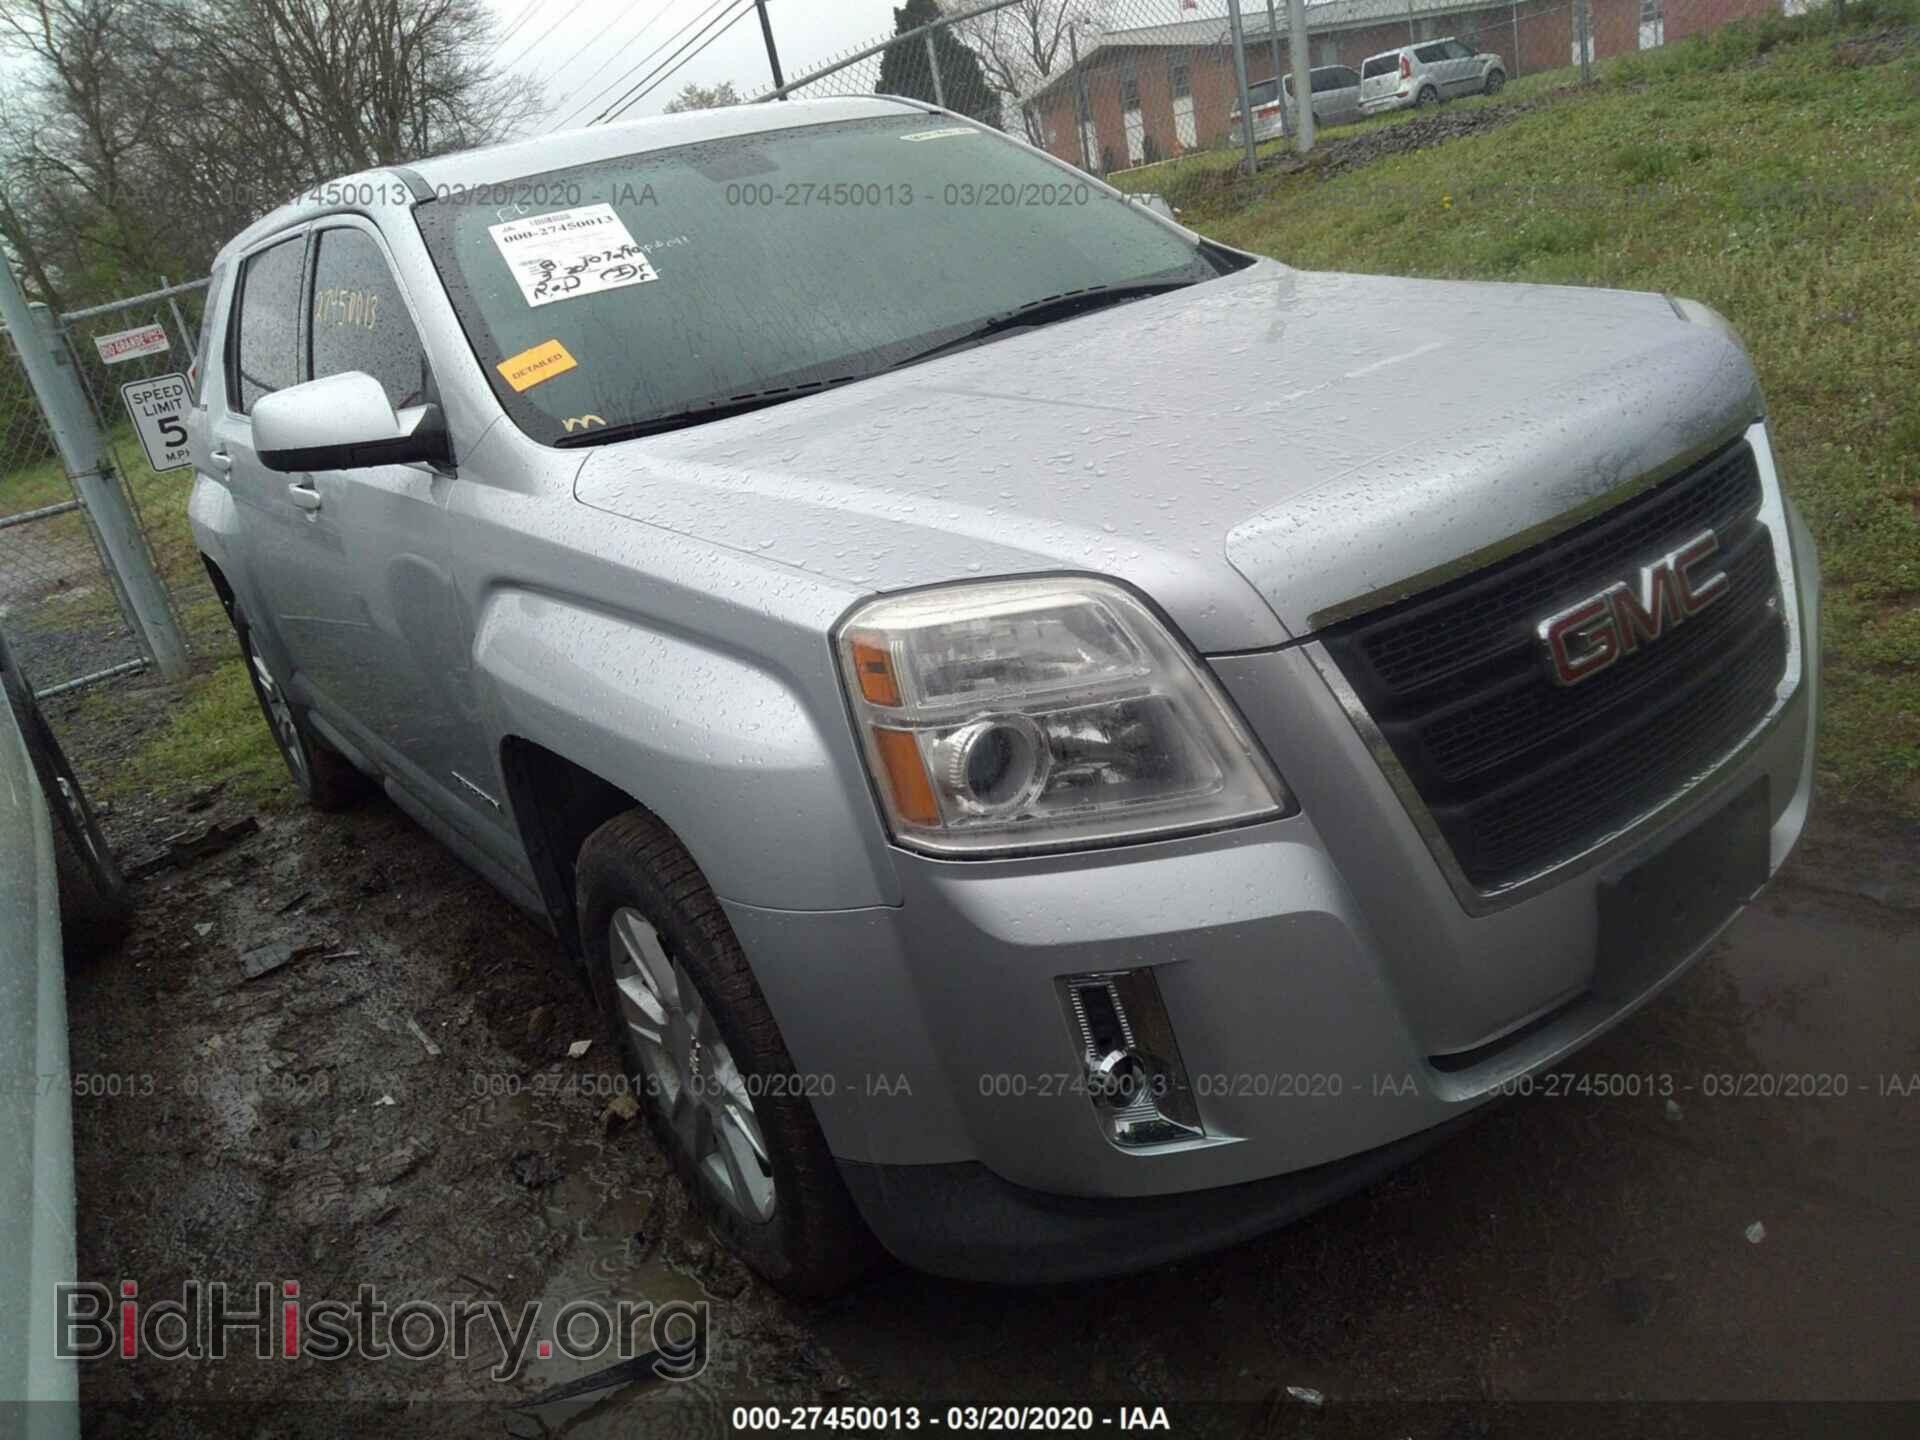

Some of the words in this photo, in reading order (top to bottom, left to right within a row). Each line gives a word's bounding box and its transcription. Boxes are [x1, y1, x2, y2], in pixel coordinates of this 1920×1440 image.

[504, 215, 614, 244] 000-27450013
[511, 352, 563, 380] DETAILED
[132, 384, 184, 405] SPEED
[143, 398, 183, 417] LIMIT
[157, 415, 188, 448] 5
[1537, 529, 1731, 688] GMC
